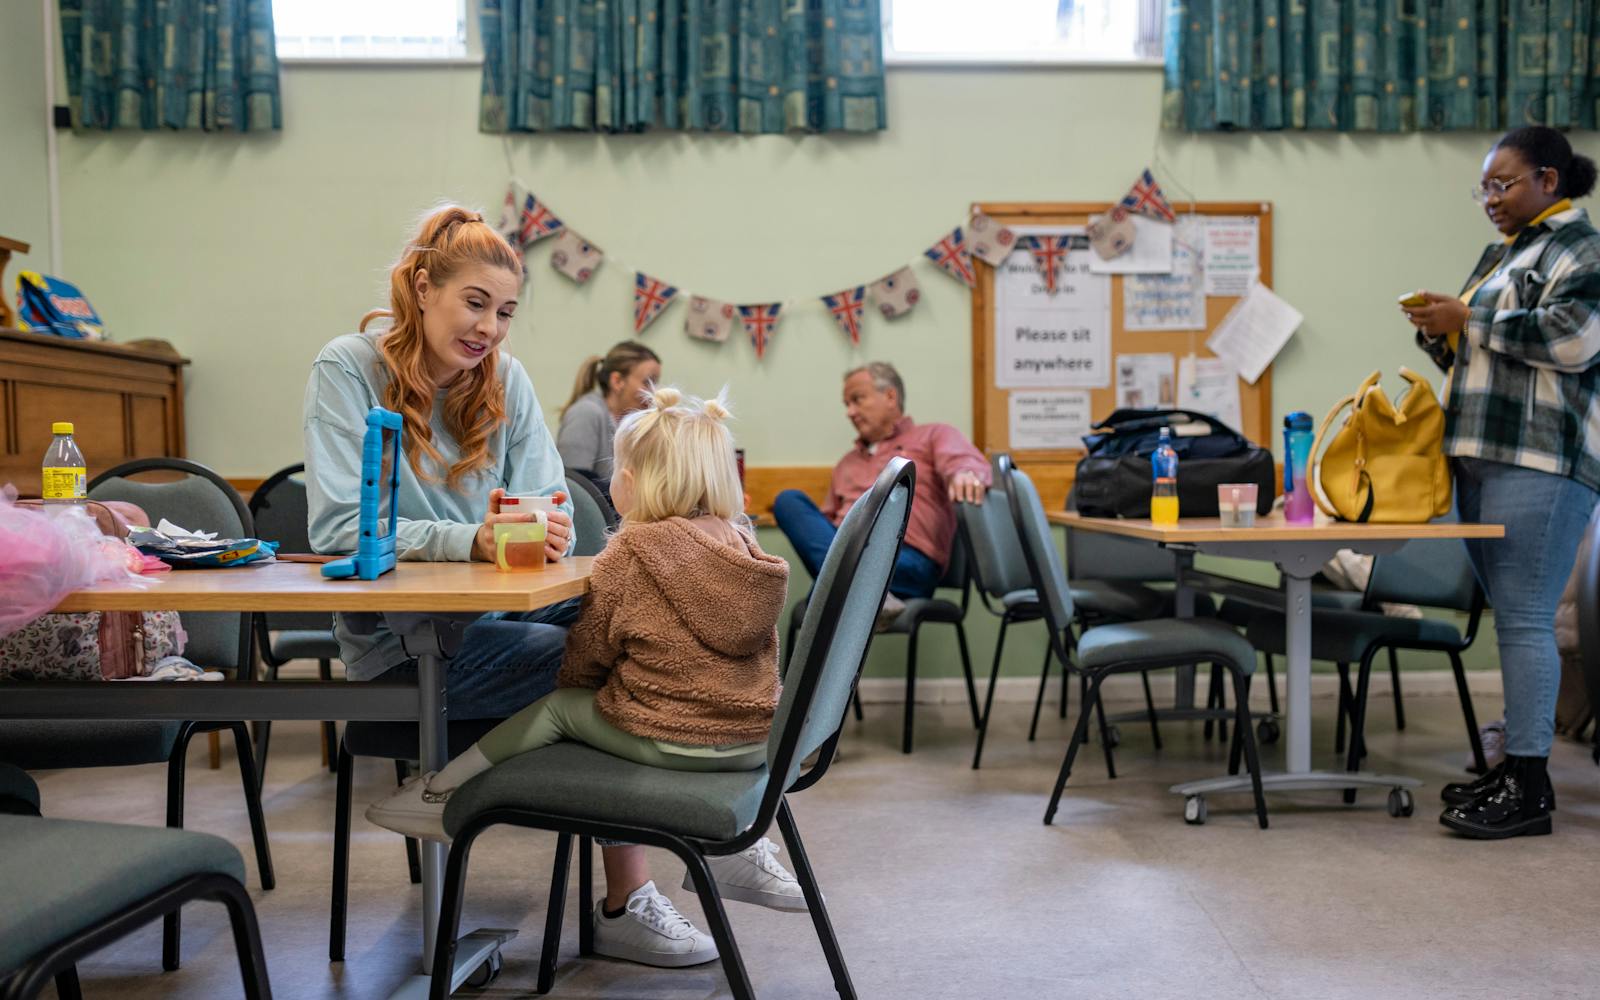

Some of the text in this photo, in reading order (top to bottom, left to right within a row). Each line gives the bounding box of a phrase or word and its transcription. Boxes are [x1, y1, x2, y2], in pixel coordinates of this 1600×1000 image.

[1015, 326, 1091, 342] Please sit
[1014, 354, 1093, 374] anywhere
